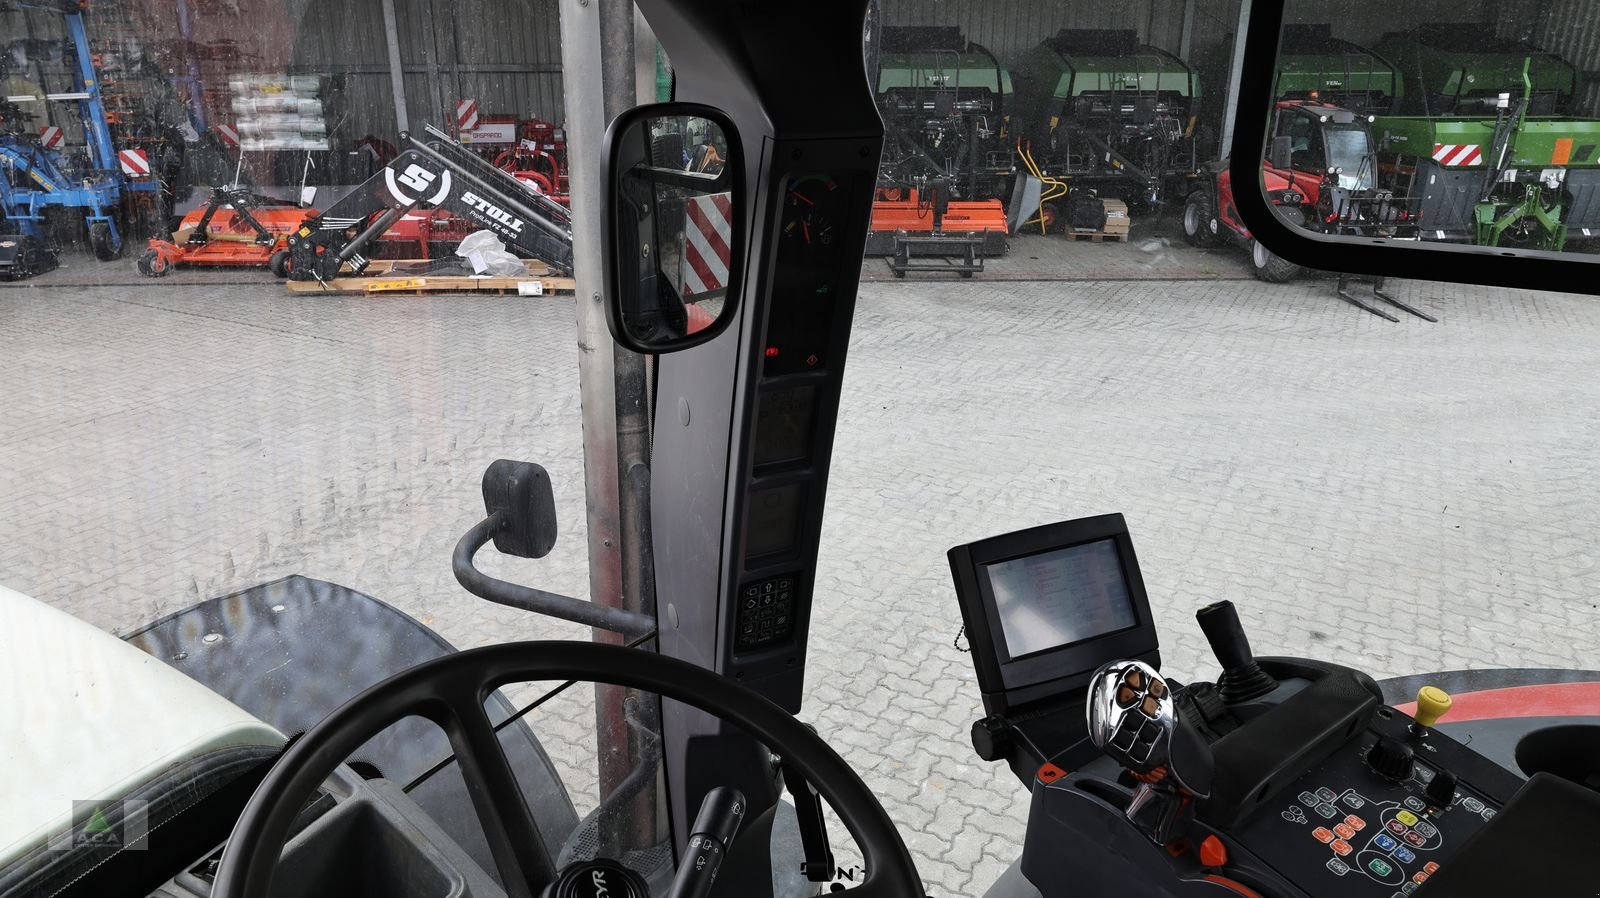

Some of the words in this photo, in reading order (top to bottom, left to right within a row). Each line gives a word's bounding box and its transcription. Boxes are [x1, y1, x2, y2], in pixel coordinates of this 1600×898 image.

[398, 163, 437, 192] S
[460, 191, 524, 233] STOLL
[492, 222, 501, 231] FZ
